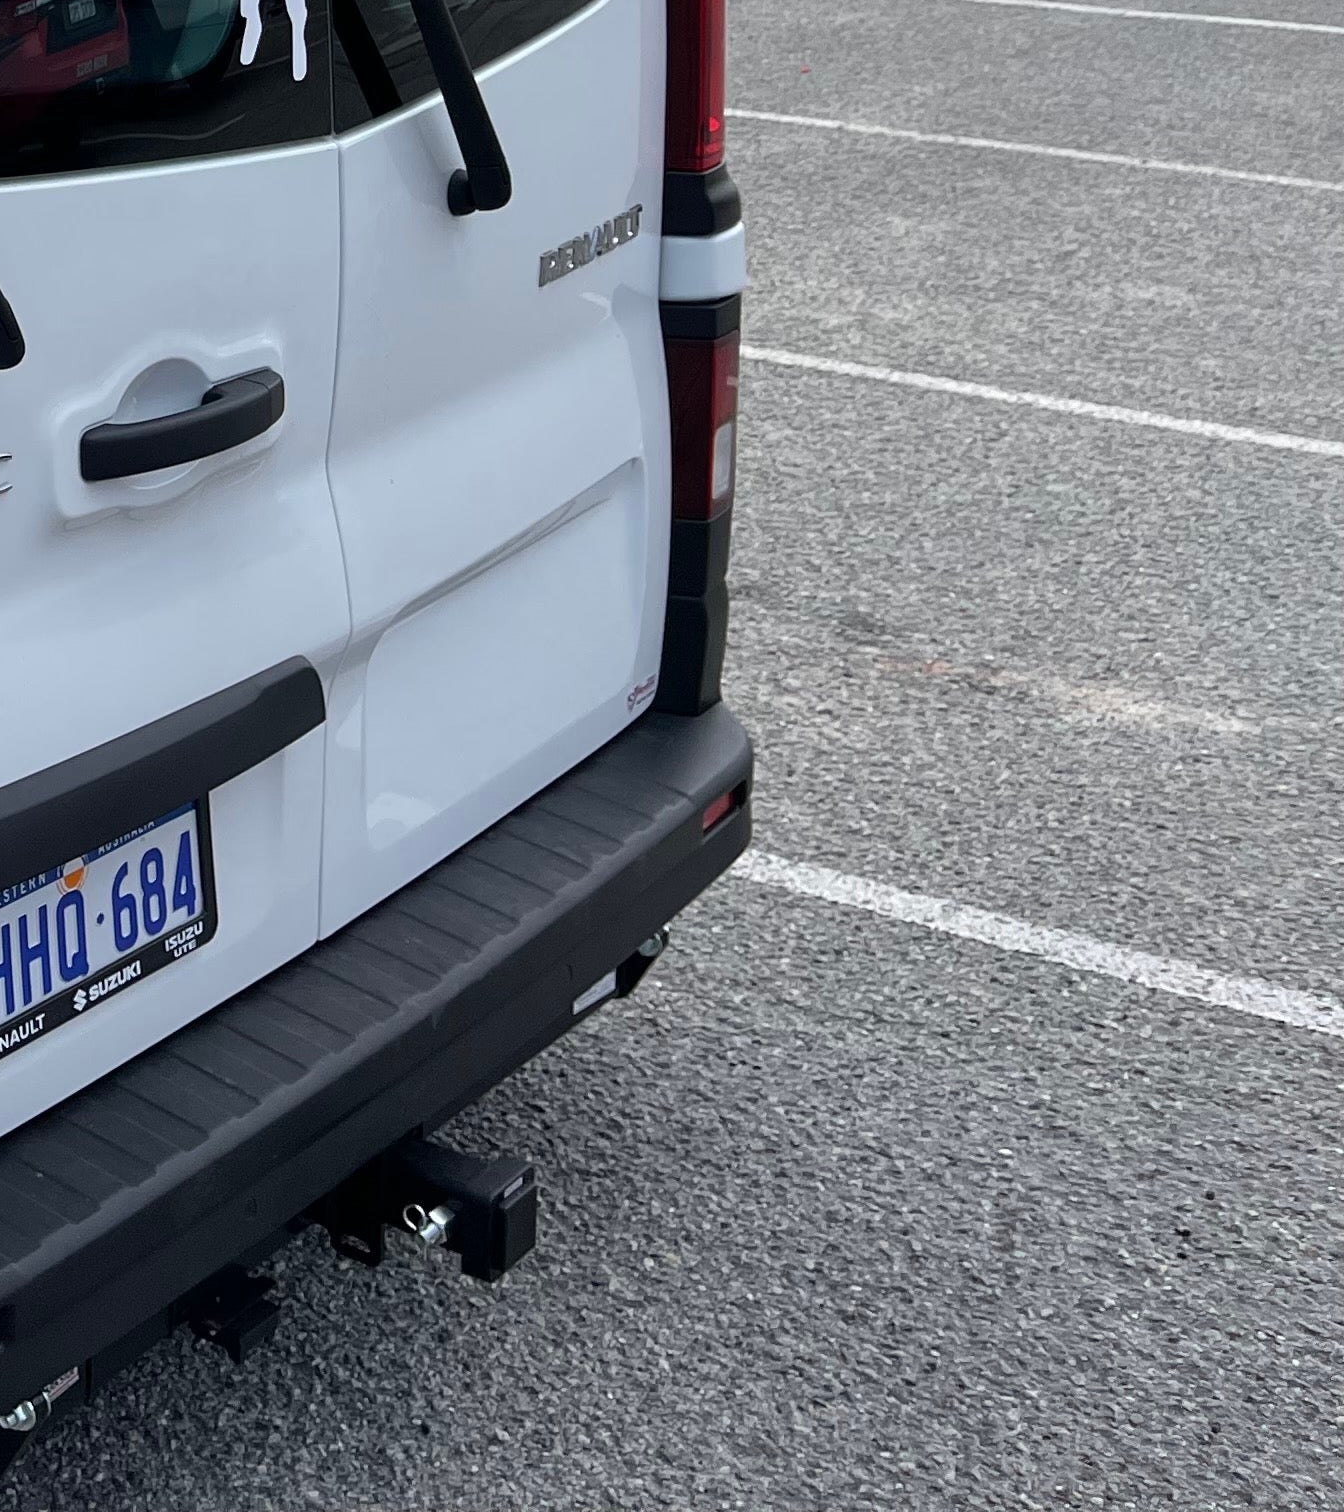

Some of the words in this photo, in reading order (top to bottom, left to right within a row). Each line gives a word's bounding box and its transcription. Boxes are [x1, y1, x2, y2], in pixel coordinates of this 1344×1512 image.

[165, 921, 204, 952] ISUZU
[173, 940, 197, 958] UTE
[89, 960, 141, 1002] SUZUKI
